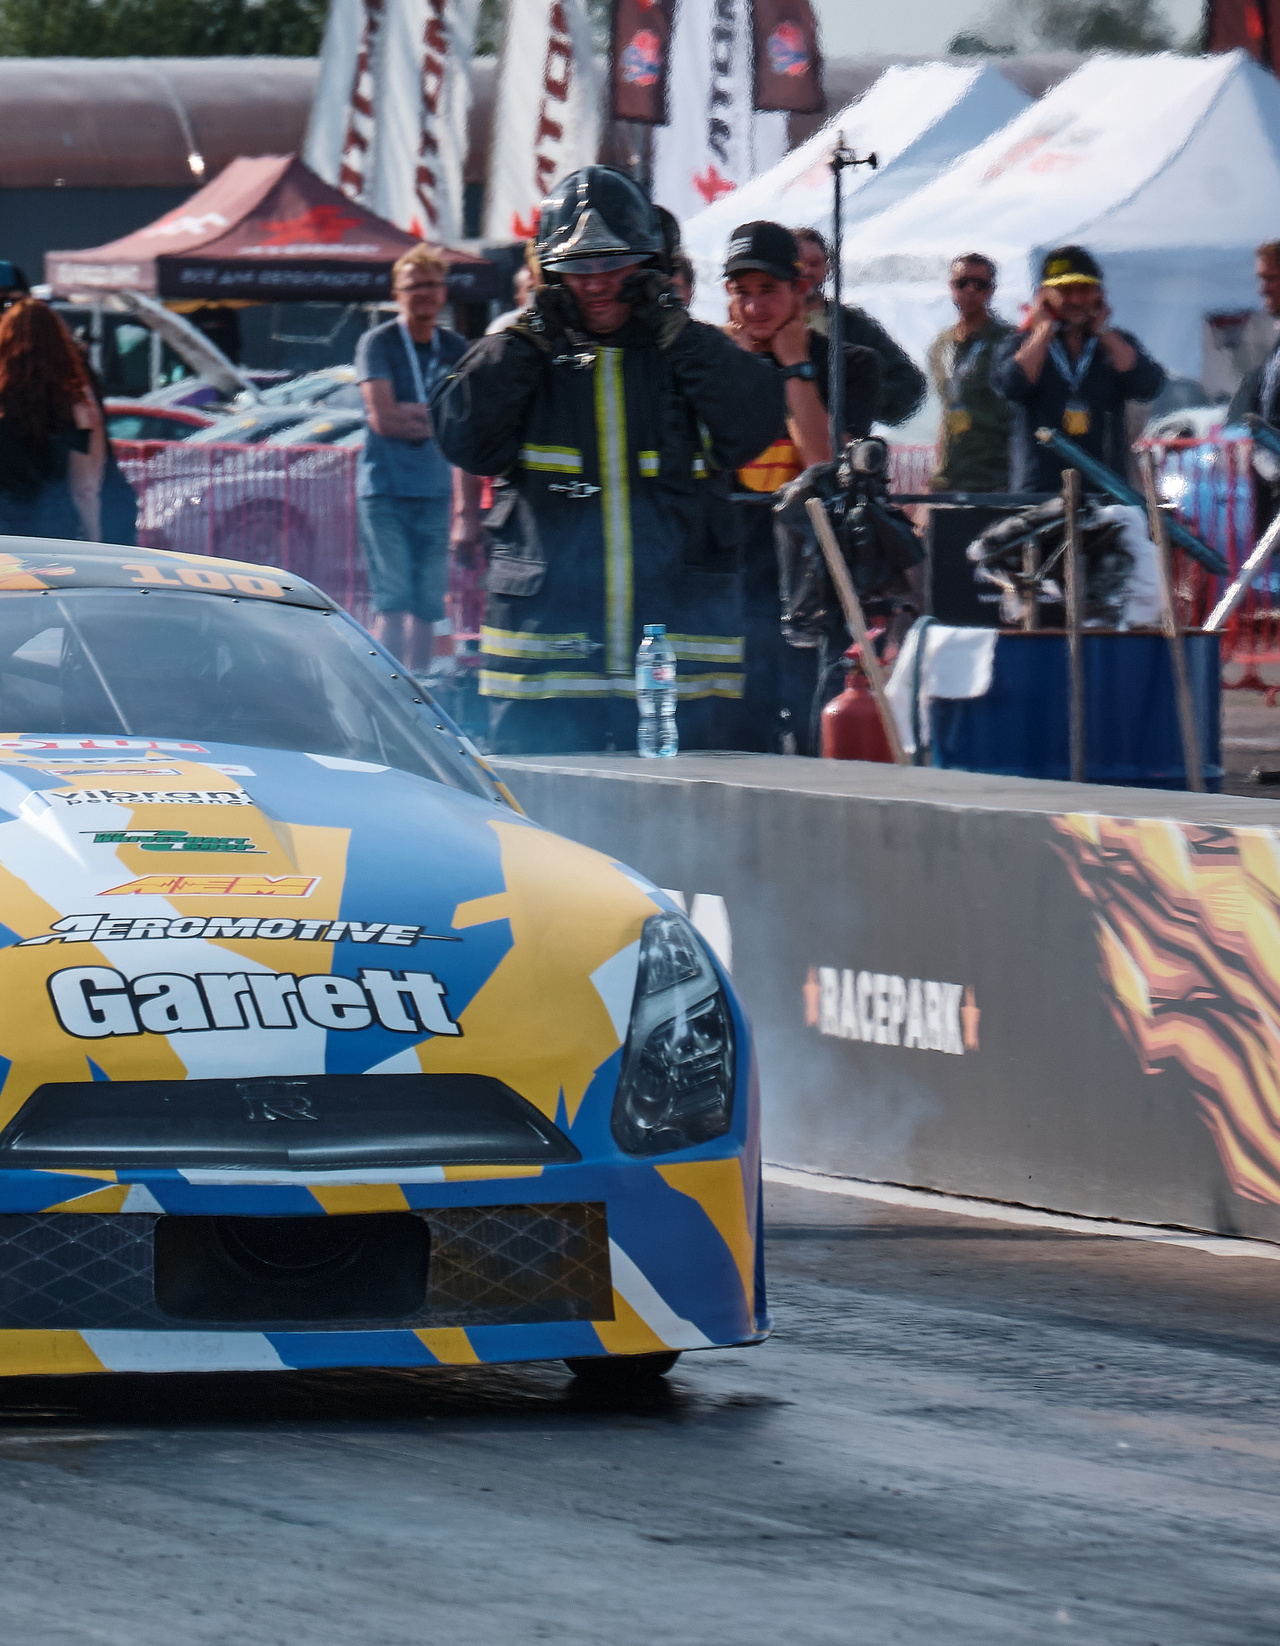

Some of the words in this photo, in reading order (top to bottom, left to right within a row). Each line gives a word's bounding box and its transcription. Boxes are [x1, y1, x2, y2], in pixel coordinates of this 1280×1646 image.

[122, 563, 285, 598] 100
[96, 875, 321, 897] AEM
[13, 912, 462, 947] AEROMOTIVE
[47, 965, 464, 1039] Garrett
[819, 966, 964, 1056] RACEPARK
